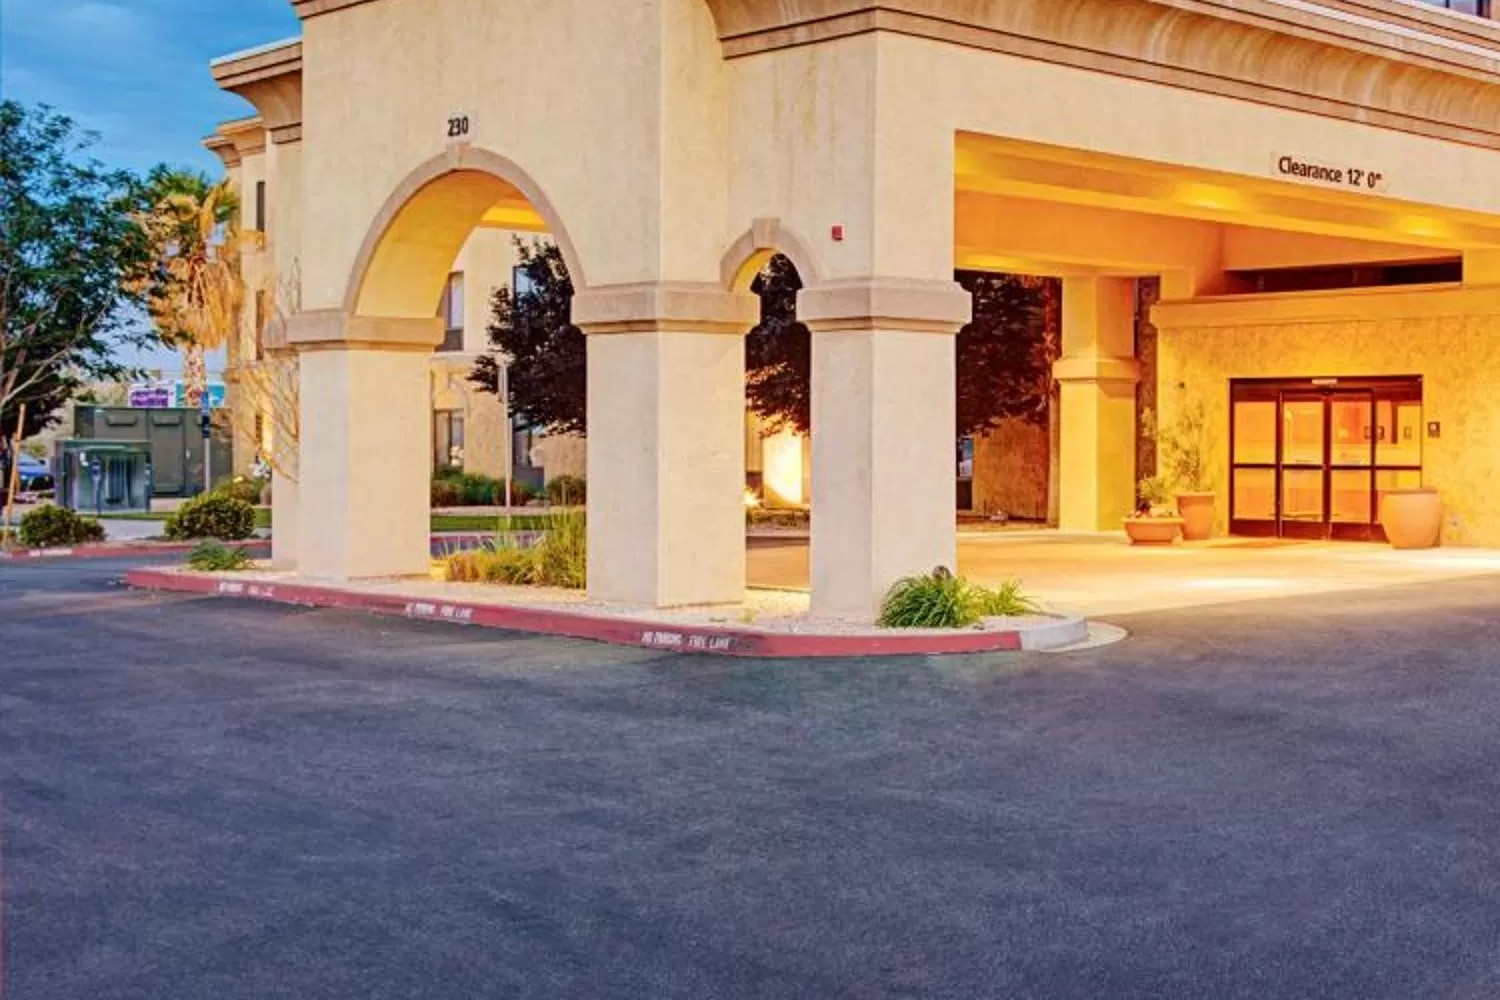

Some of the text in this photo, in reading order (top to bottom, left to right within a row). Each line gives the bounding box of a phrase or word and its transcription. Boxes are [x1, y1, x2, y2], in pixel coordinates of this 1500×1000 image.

[447, 116, 469, 137] 230
[1278, 156, 1343, 183] Clearance
[1347, 167, 1365, 187] 12'
